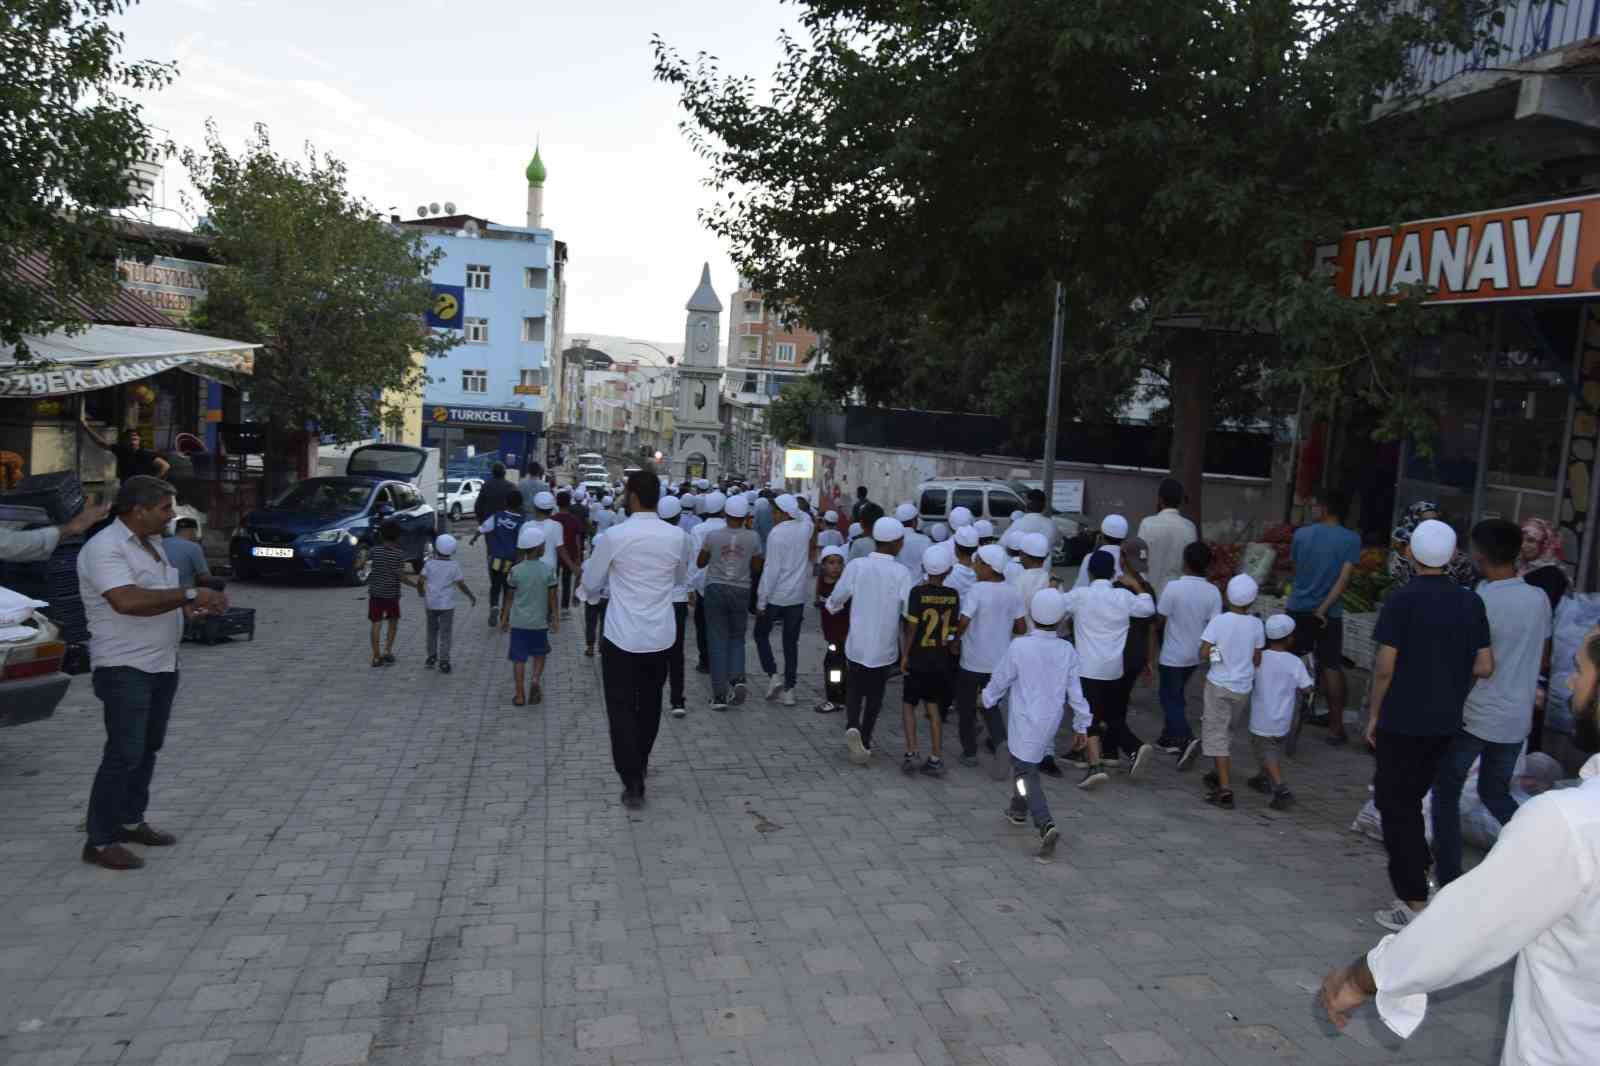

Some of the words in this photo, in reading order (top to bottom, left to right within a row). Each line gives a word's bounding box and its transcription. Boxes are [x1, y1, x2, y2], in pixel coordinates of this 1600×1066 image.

[1351, 211, 1582, 297] MANAVI
[449, 408, 513, 423] TURKCELL
[920, 607, 952, 648] 21
